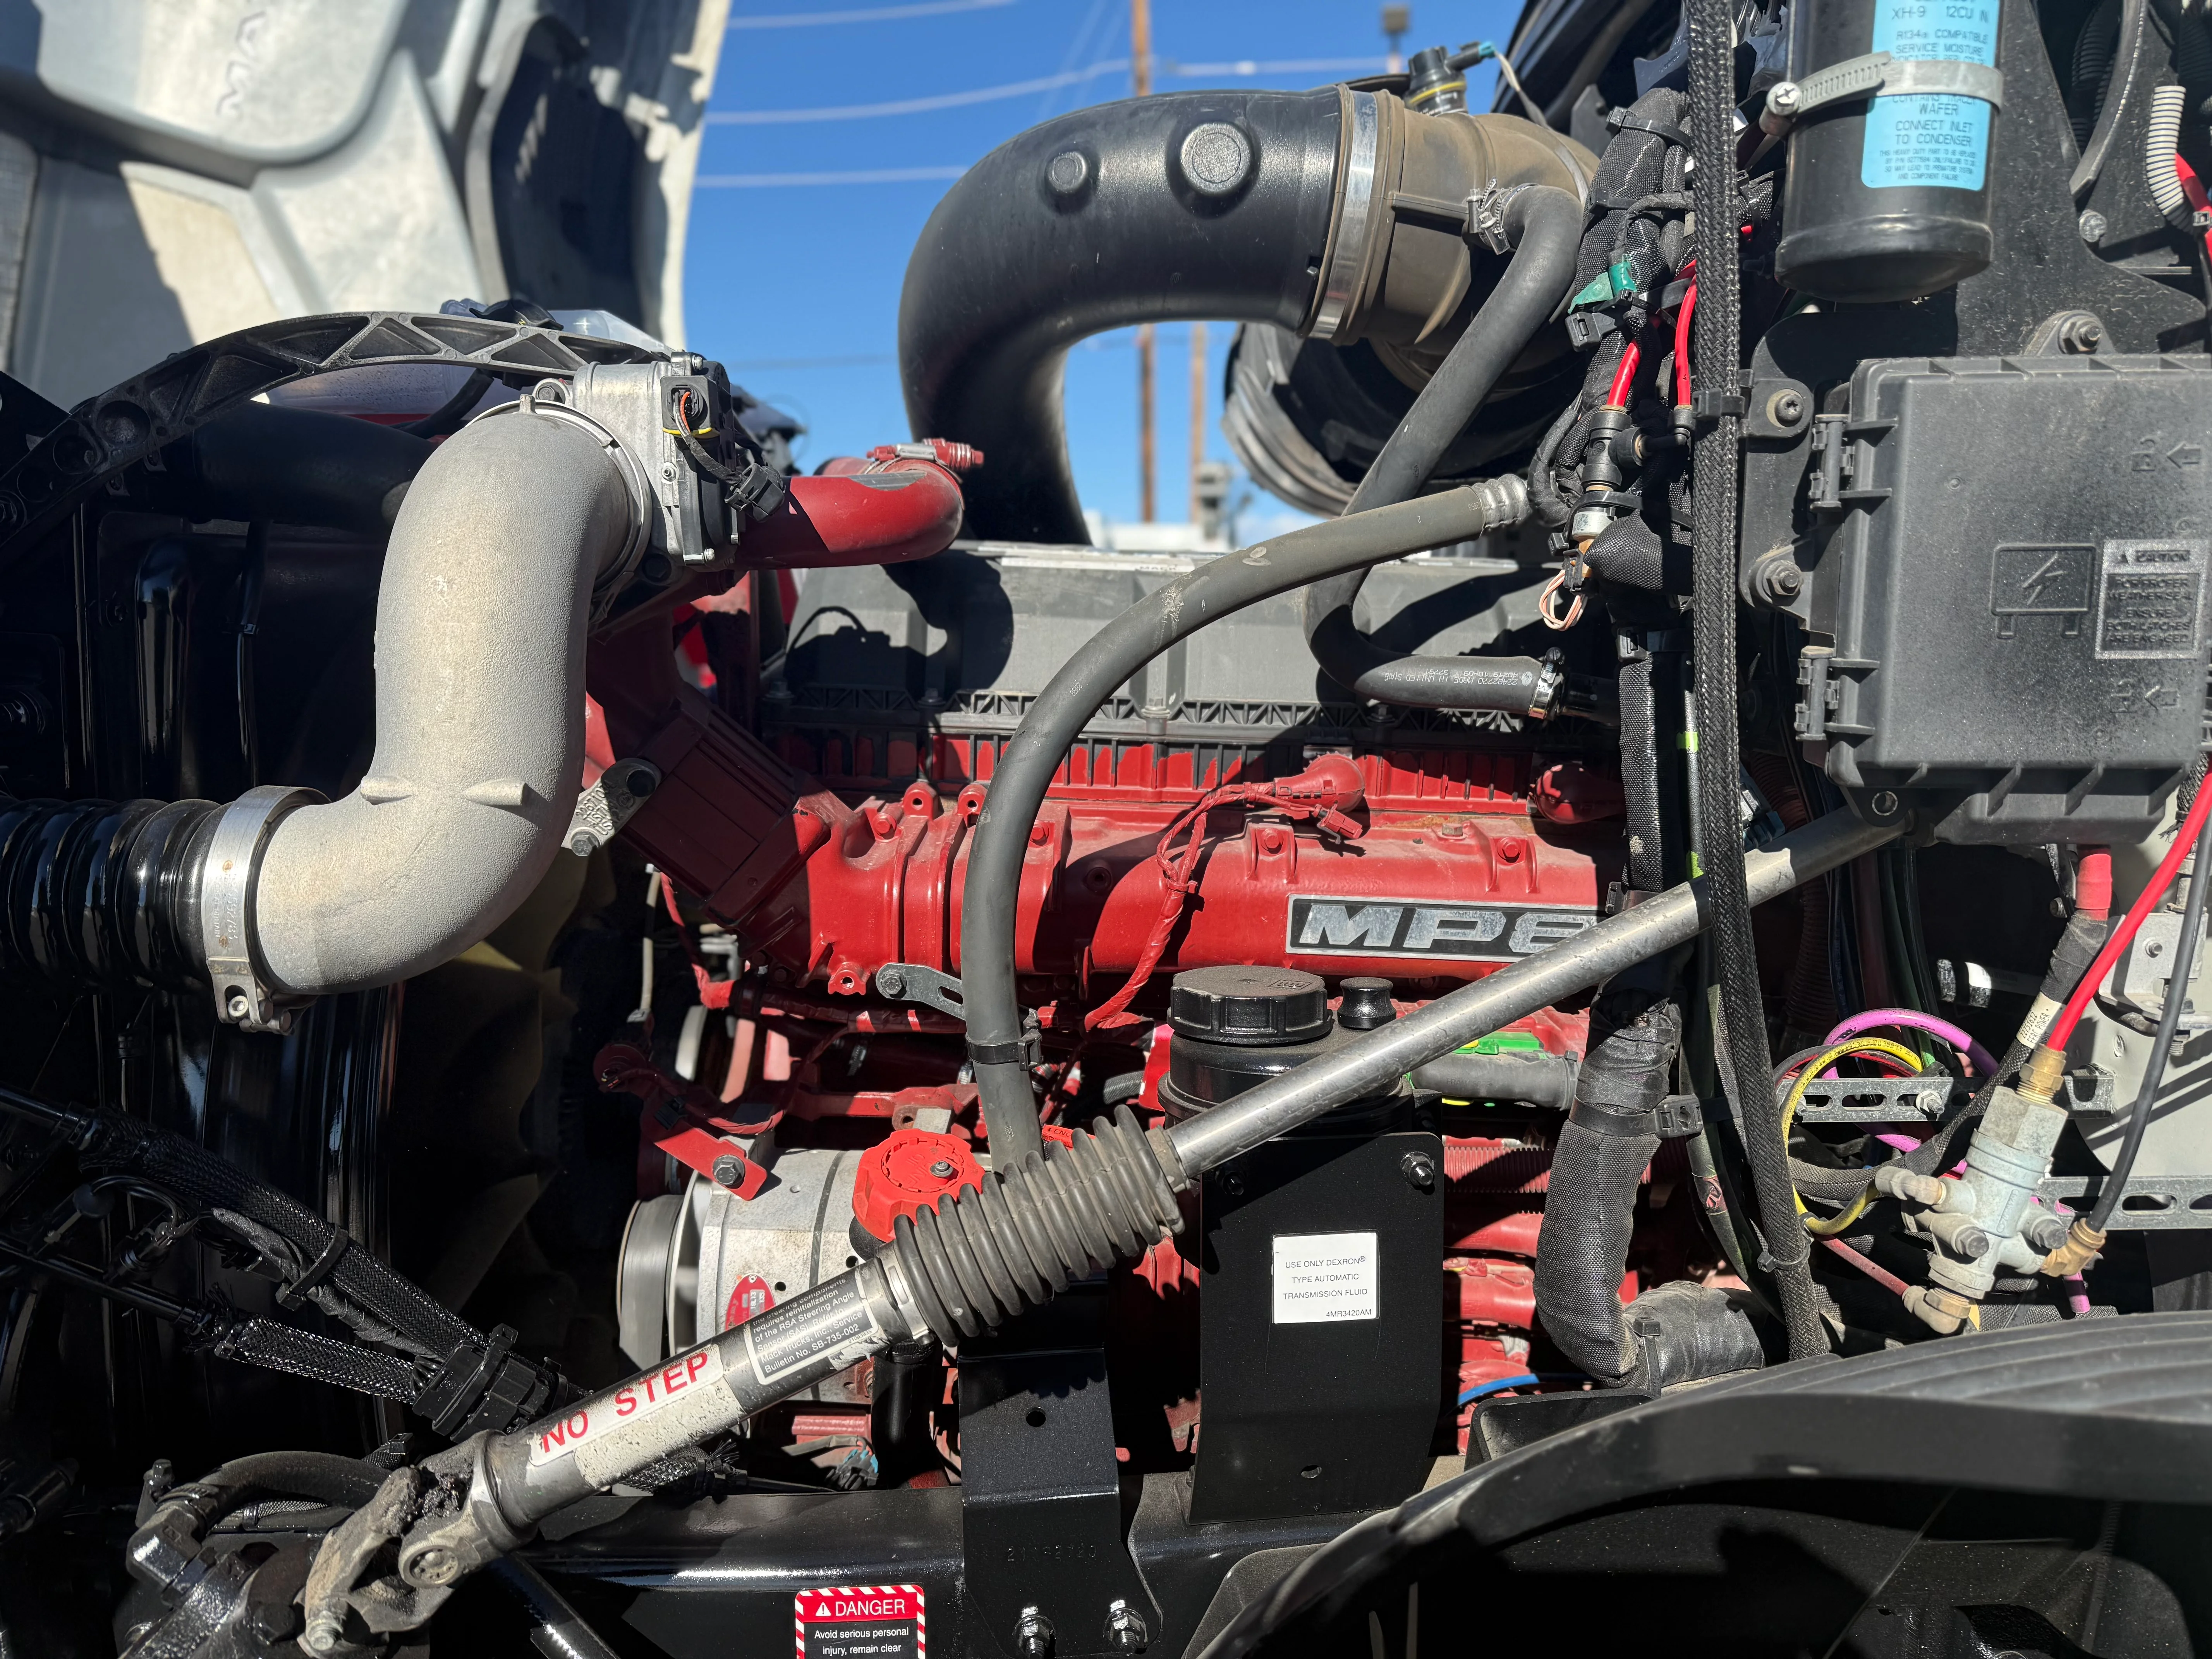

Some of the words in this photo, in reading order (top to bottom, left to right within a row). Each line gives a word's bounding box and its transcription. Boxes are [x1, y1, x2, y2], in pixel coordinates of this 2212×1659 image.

[1892, 6, 1926, 19] XH-9
[1935, 29, 1989, 45] COMPATIBLE
[1896, 43, 1937, 54] SERVICE
[1944, 43, 1984, 57] MOISTURE
[1919, 103, 1958, 115] WAFER
[1895, 120, 1943, 131] CONNECT
[1895, 134, 1909, 144] TO
[1917, 134, 1972, 147] CONDENSER
[1300, 903, 1597, 953] MP8
[2020, 1011, 2037, 1039] 22751612
[2035, 1012, 2051, 1030] POWER
[1314, 1273, 1359, 1282] AUTOMATIC
[1283, 1290, 1343, 1300] TRANSMISSION
[753, 1315, 784, 1334] requires
[786, 1289, 838, 1319] reinitialization
[755, 1334, 764, 1343] of
[764, 1326, 778, 1337] the
[779, 1319, 797, 1332] RSA
[798, 1302, 831, 1322] Steering
[832, 1291, 855, 1307] Angle
[1326, 1309, 1372, 1317] 4MR3420AM
[757, 1336, 785, 1353] Sensor
[760, 1348, 784, 1364] Mack
[785, 1334, 814, 1353] Trucks,
[832, 1310, 863, 1330] Service
[764, 1355, 795, 1374] Bulletin
[795, 1349, 811, 1360] No.
[811, 1323, 860, 1352] SB-735-002
[541, 1410, 588, 1453] NO
[615, 1352, 709, 1417] STEP
[835, 1599, 905, 1616] DANGER
[814, 1629, 838, 1639] Avoid
[840, 1628, 871, 1638] serious
[872, 1626, 909, 1639] personal
[823, 1645, 847, 1657] injury,
[850, 1644, 879, 1654] remain
[881, 1643, 902, 1652] clear
